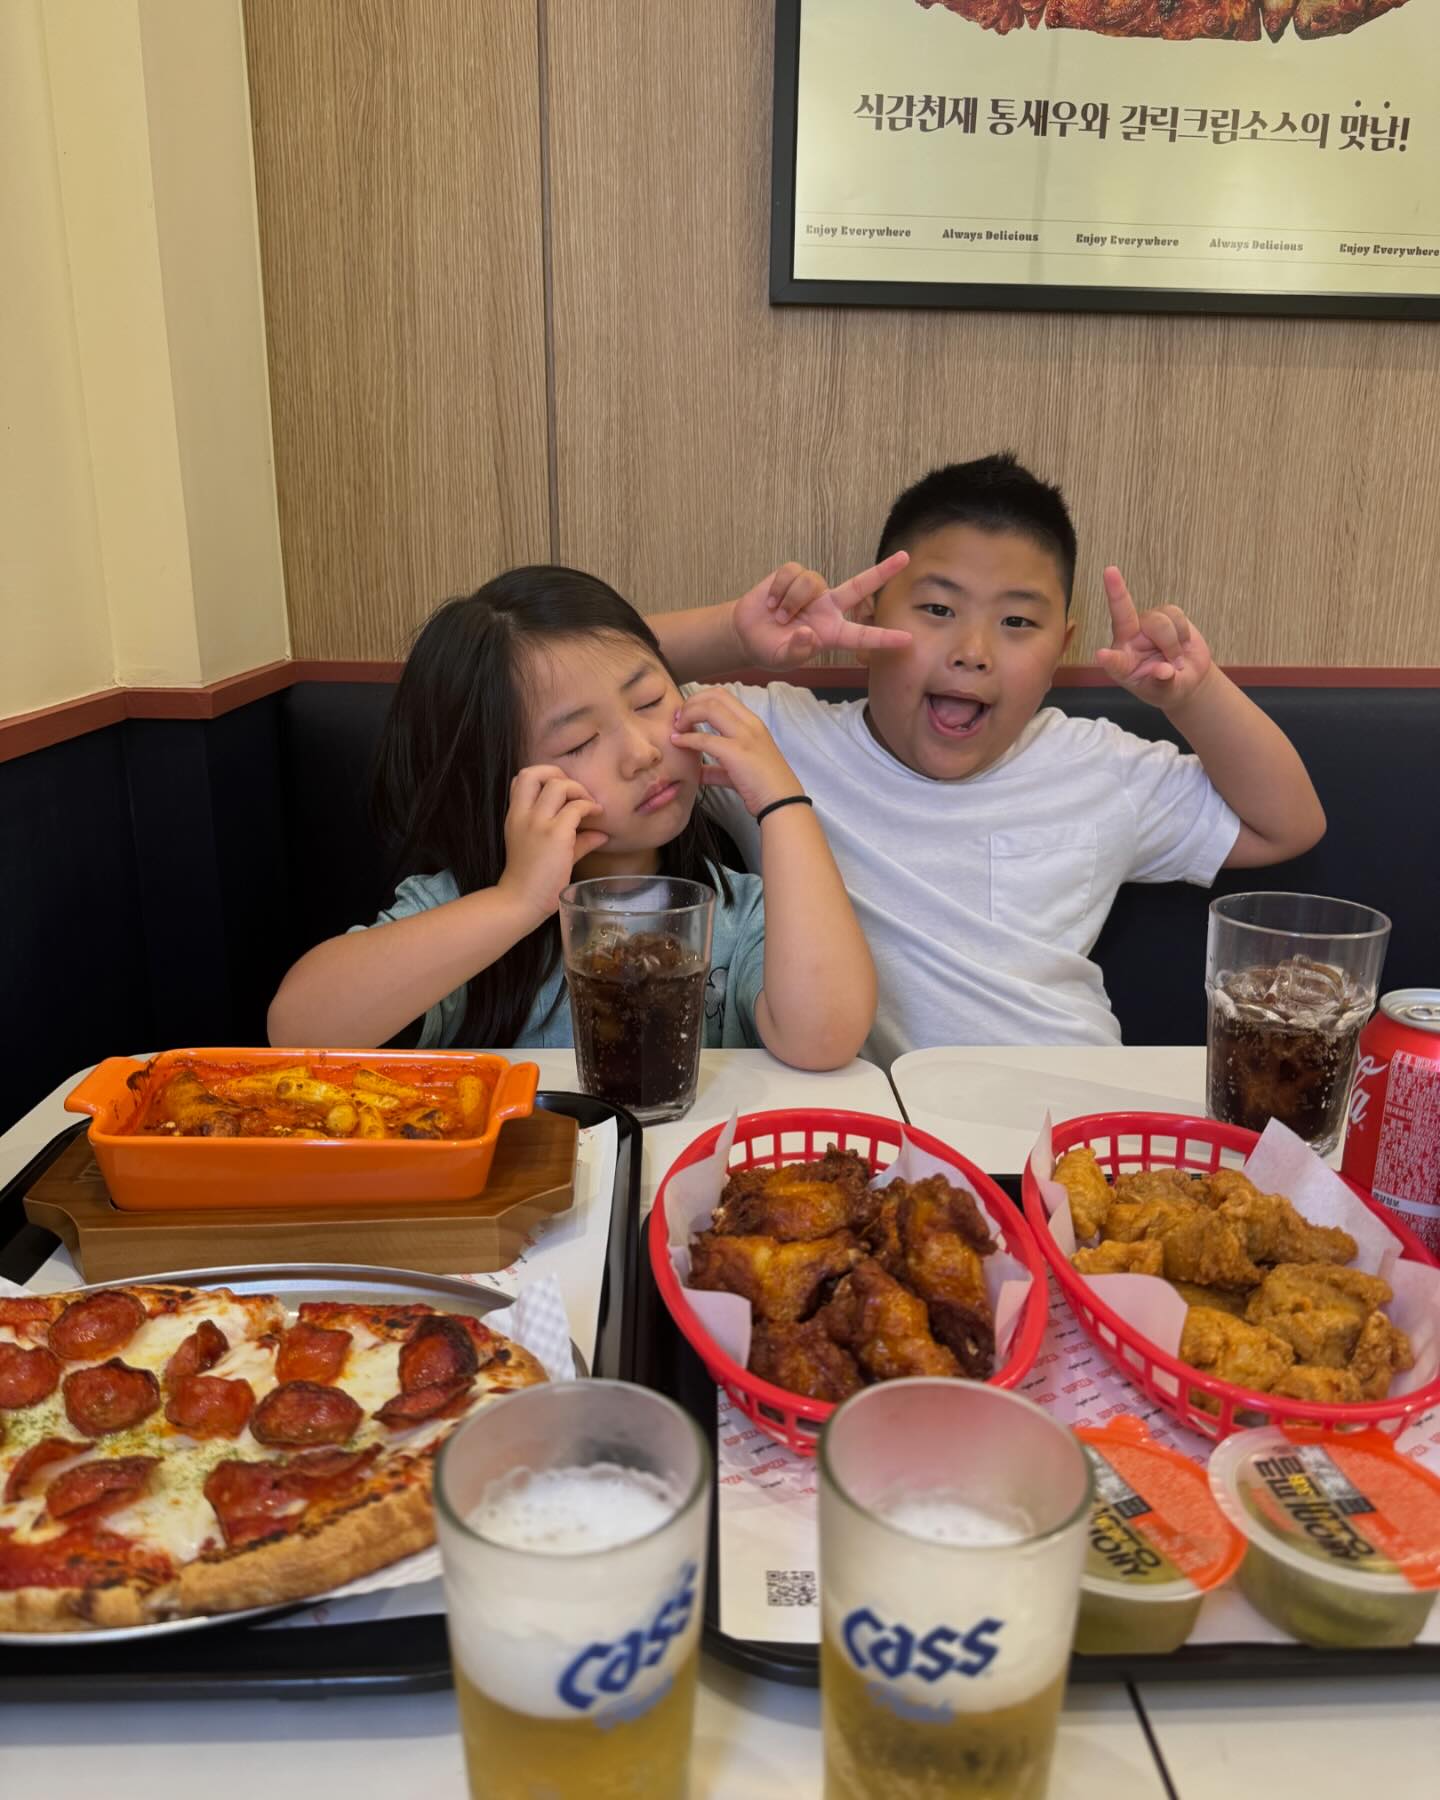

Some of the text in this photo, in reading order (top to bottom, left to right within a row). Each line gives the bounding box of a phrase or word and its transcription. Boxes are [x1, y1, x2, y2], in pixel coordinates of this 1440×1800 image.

[853, 93, 1411, 153] 식감천재 통새우와 갈릭크림소스의 맛남!
[806, 223, 912, 240] Enjoy Everywhere
[942, 228, 1040, 243] Always Delicious
[1075, 233, 1180, 249] Enjoy Everywhere
[1209, 238, 1305, 252] Always Delicious
[1339, 243, 1440, 259] Enjoy Everywhere
[842, 1606, 1005, 1685] Cass
